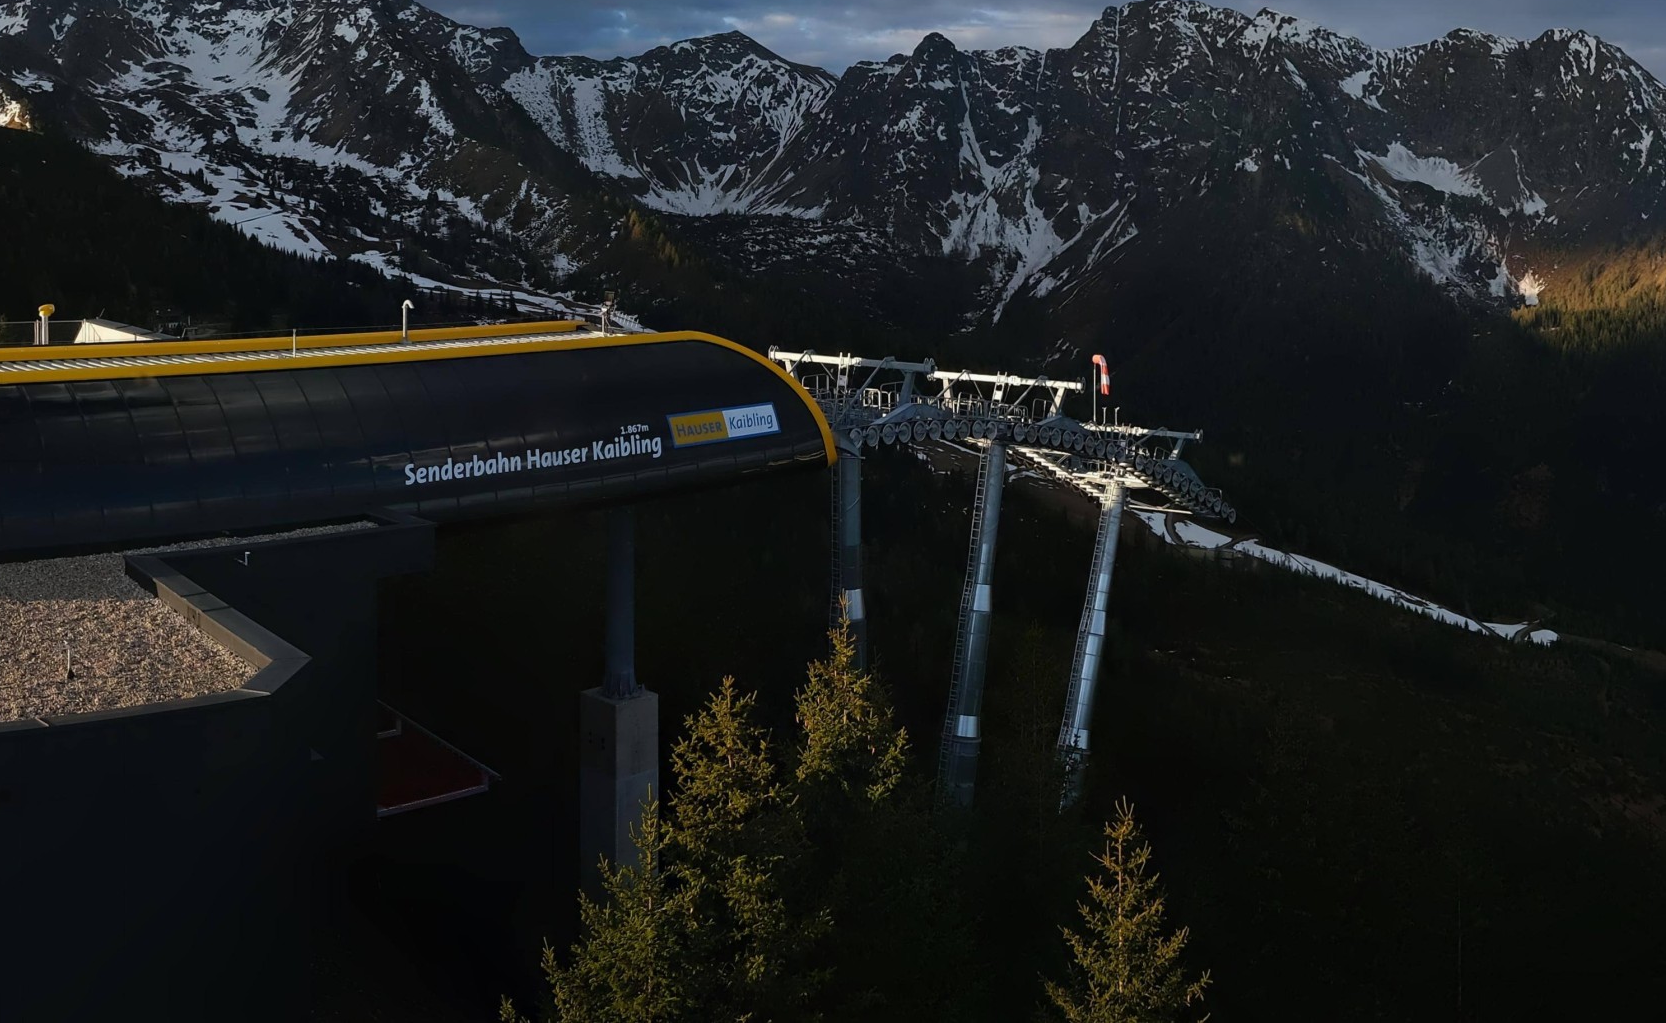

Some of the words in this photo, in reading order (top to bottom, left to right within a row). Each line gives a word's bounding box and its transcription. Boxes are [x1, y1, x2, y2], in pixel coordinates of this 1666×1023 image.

[620, 424, 649, 435] 1.867m
[676, 421, 722, 438] HAUSER
[729, 413, 773, 430] Kaibling
[404, 452, 521, 485] Senderbahn
[526, 446, 588, 470] Hauser
[592, 434, 662, 461] Kaibling
